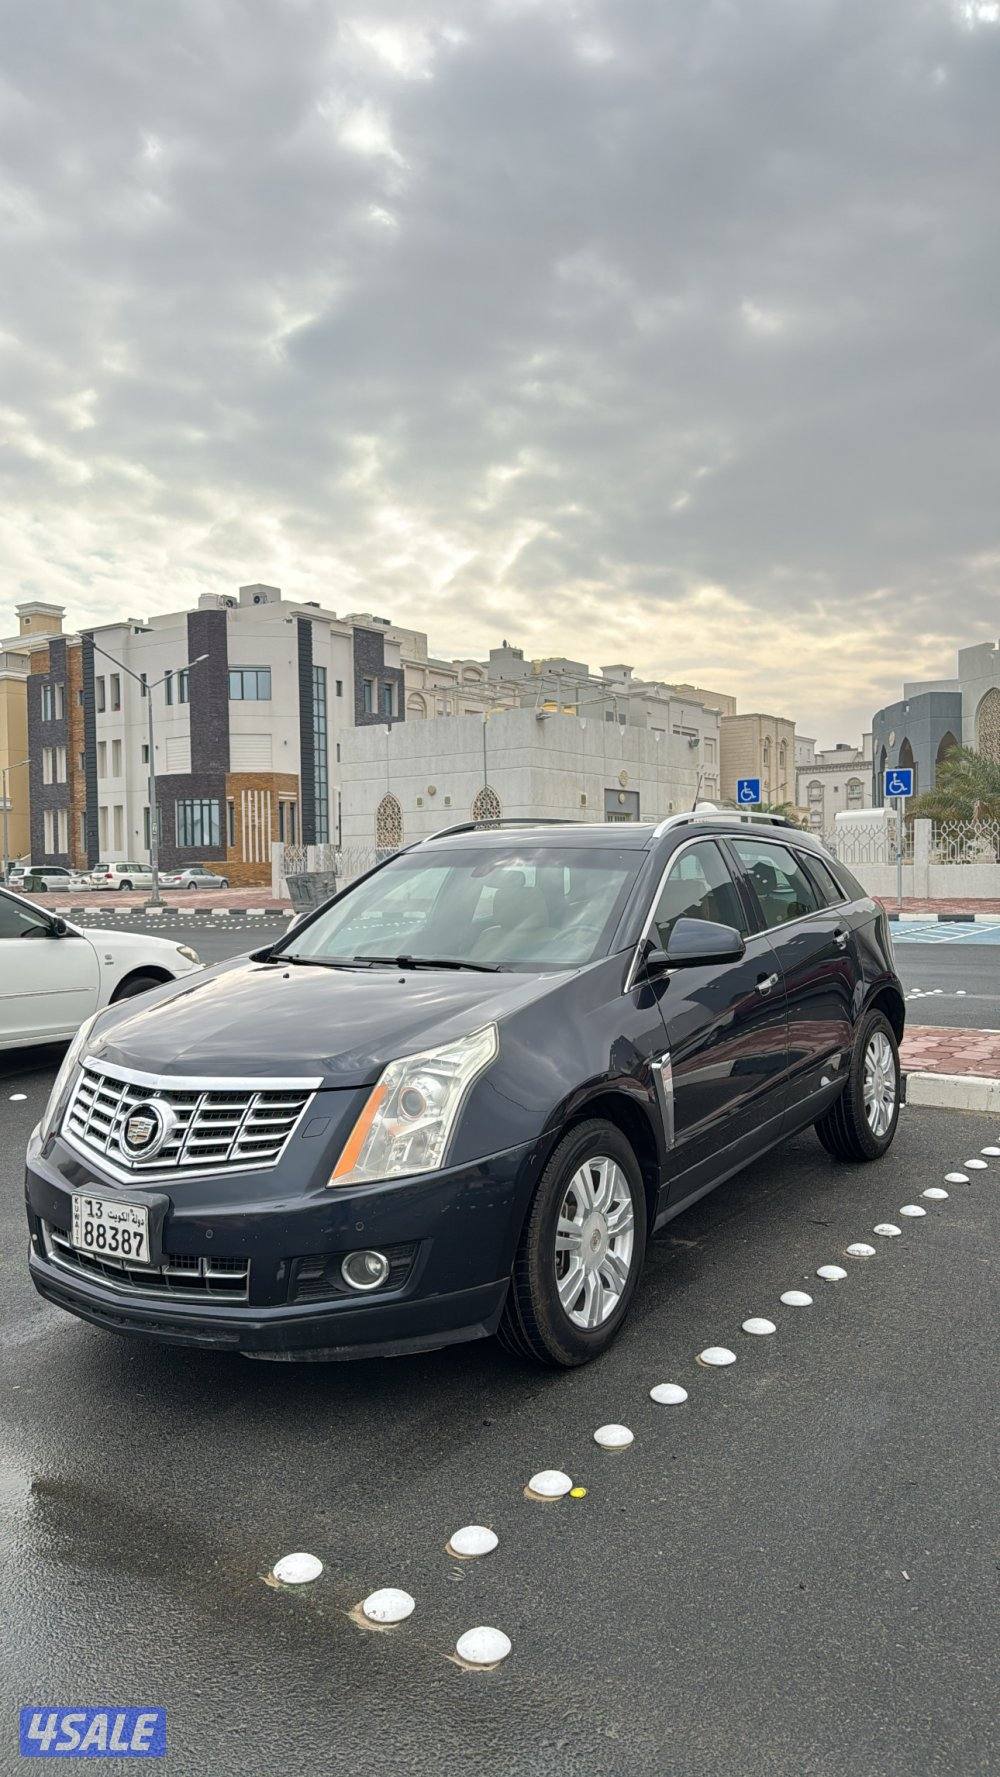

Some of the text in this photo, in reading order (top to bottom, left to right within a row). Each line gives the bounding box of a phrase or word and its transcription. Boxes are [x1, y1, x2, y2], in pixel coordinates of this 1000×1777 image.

[84, 1200, 103, 1219] 13
[108, 1211, 130, 1223] الكويت
[84, 1221, 144, 1257] 88387
